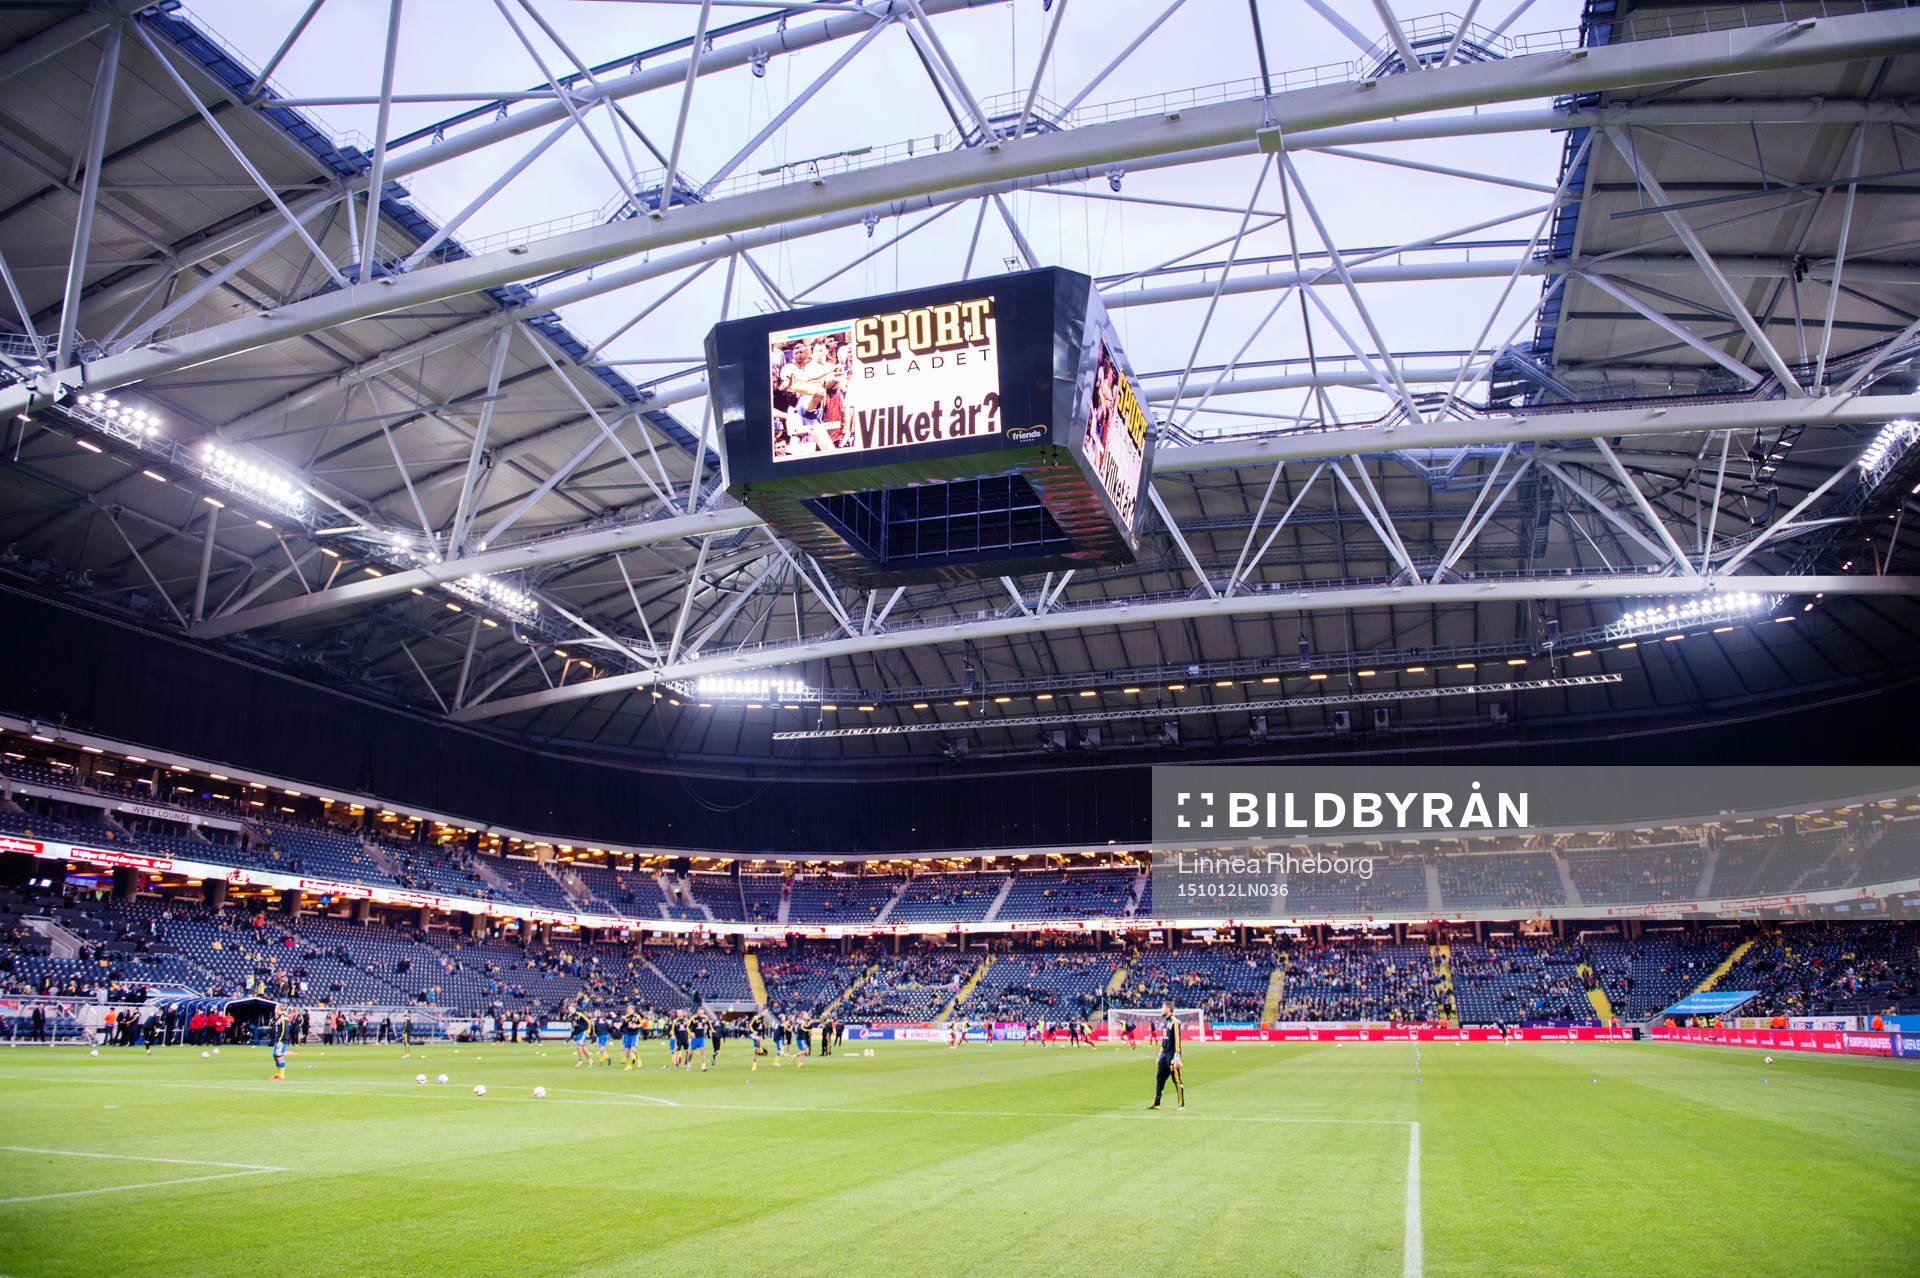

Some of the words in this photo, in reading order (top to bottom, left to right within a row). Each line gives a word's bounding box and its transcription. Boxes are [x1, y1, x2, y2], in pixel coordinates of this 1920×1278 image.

[854, 296, 995, 364] SPORT
[864, 348, 991, 379] BLADET
[858, 400, 943, 449] Vilket
[949, 392, 1000, 438] år?
[1012, 429, 1042, 441] friends
[1117, 370, 1147, 457] SPORT
[133, 806, 155, 815] WEST
[158, 811, 191, 822] LOUNGE
